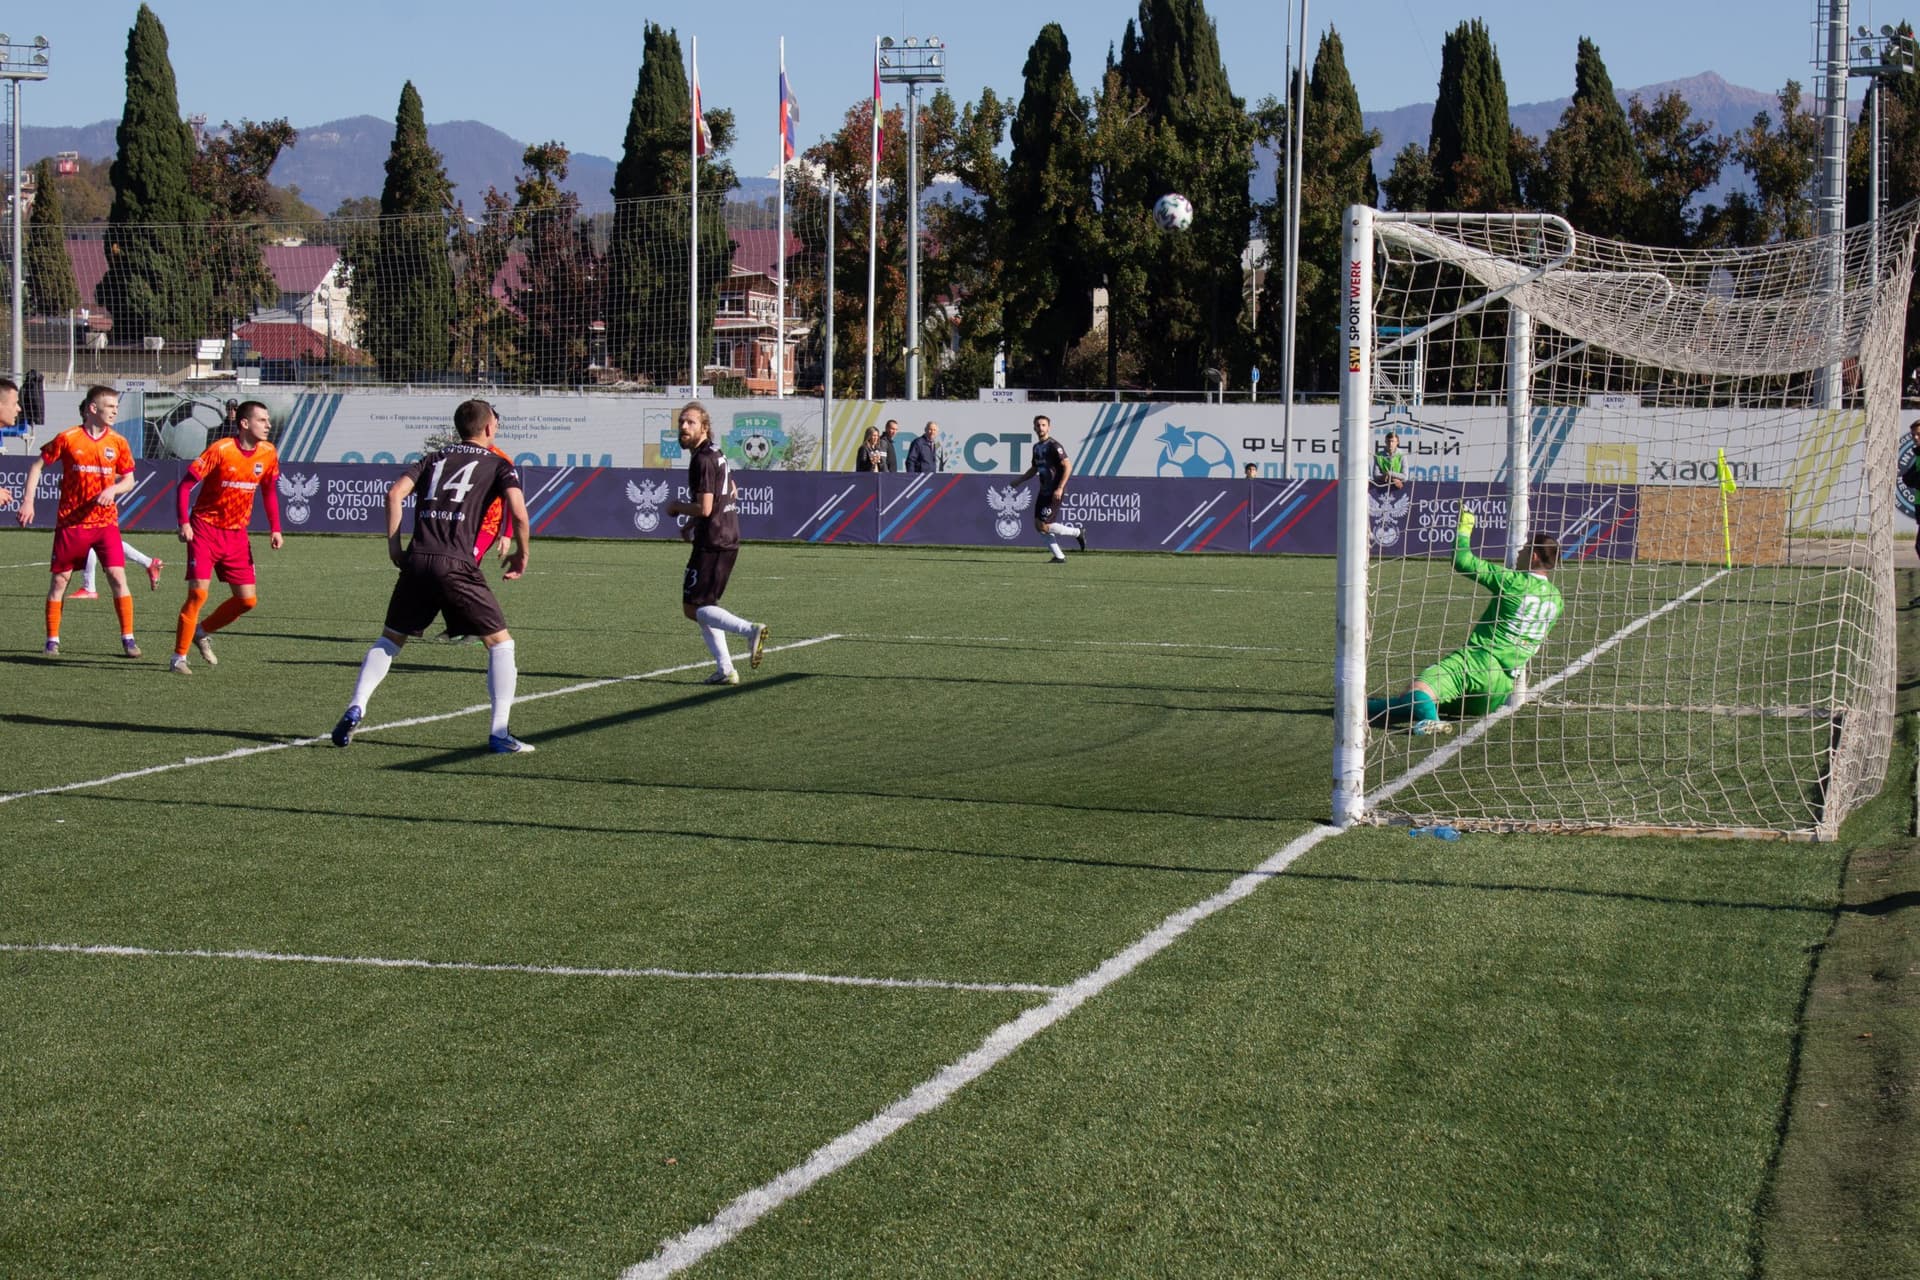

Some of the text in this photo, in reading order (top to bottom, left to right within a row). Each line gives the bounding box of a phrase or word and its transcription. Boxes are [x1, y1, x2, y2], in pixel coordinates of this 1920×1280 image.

[1242, 437, 1461, 456] ФУТБНЫЙ
[1650, 460, 1758, 481] xiaomi
[327, 479, 395, 494] РОССИЙС
[423, 457, 479, 503] 14
[327, 493, 417, 508] ФУТБОЛЬЫЙ
[1061, 491, 1141, 508] ССИЙСКИЙ
[1419, 498, 1507, 514] РОССИЙСК
[326, 507, 368, 521] СОЮЗ
[1060, 507, 1141, 523] ТБОЛЬНЫЙ
[1419, 512, 1507, 529] ФУТБЛЬН
[1418, 529, 1456, 543] СОЮ
